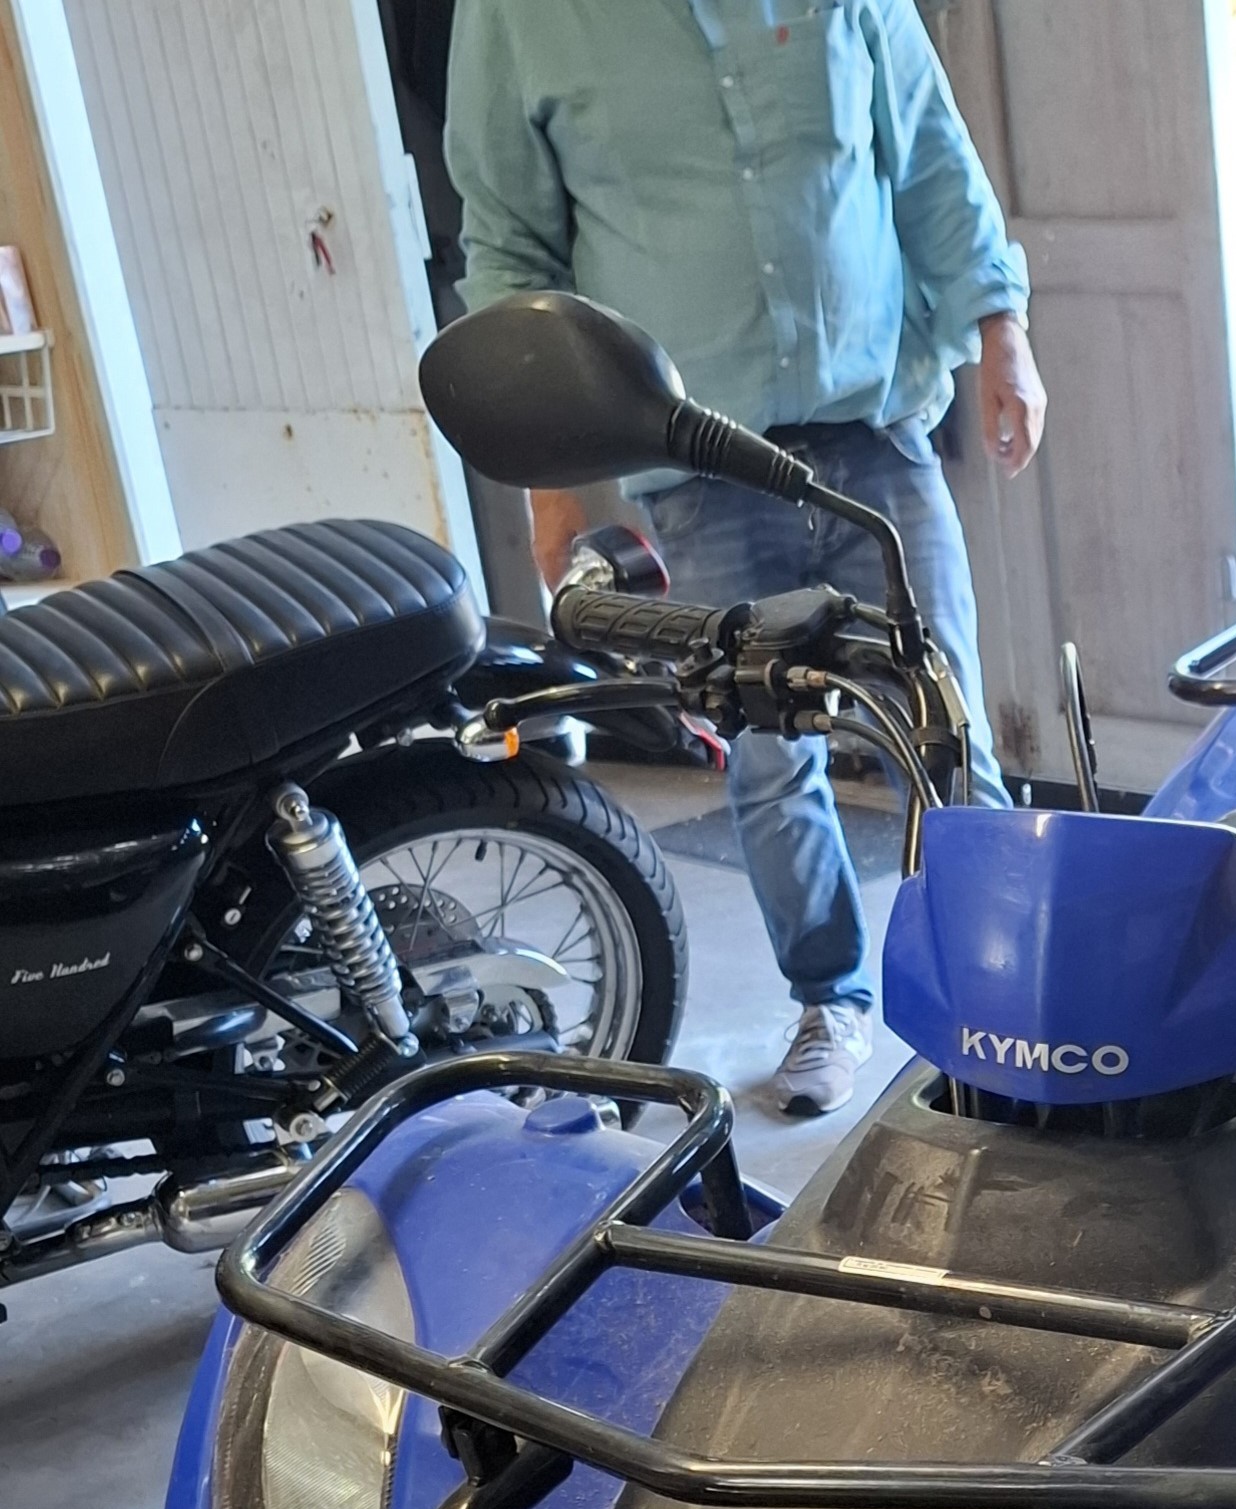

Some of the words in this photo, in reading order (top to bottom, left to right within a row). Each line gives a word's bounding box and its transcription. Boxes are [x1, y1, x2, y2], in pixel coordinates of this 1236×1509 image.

[11, 969, 45, 985] Five
[49, 951, 111, 979] Hundred
[961, 1026, 1130, 1076] KYMCO
